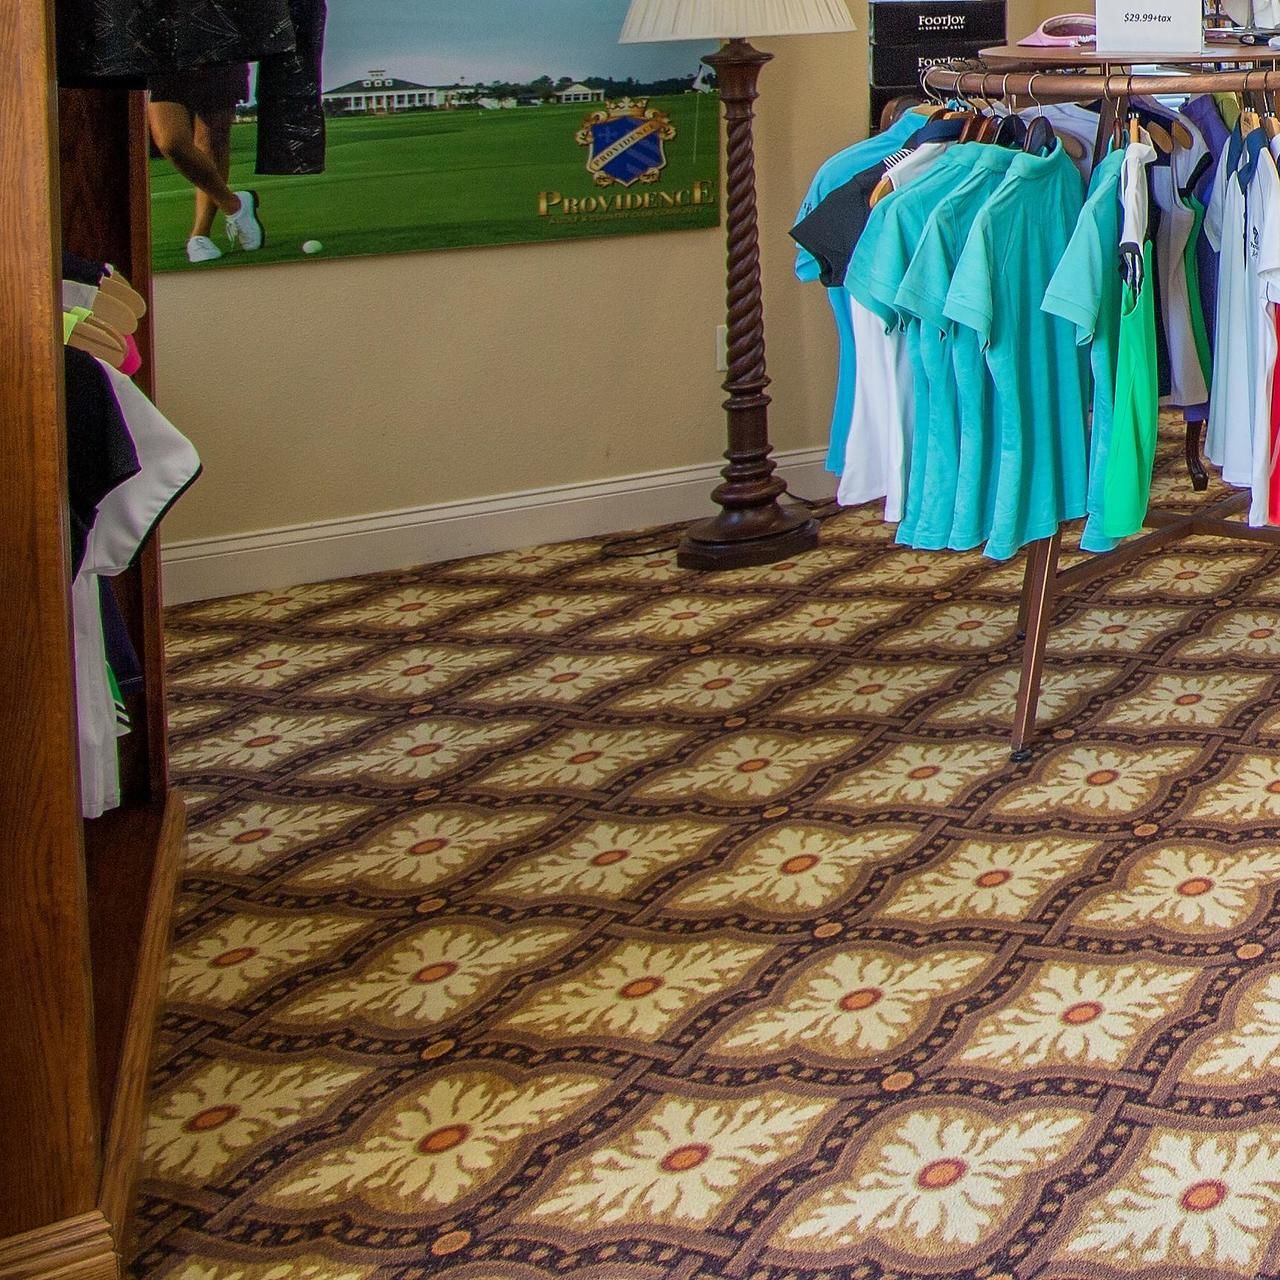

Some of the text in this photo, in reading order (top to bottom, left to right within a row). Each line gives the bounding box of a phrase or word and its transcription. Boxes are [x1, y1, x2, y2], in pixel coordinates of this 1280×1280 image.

[919, 15, 965, 26] FOOTJOY
[1124, 13, 1172, 23] $29.99+tax
[538, 180, 715, 216] PROVIDENCE
